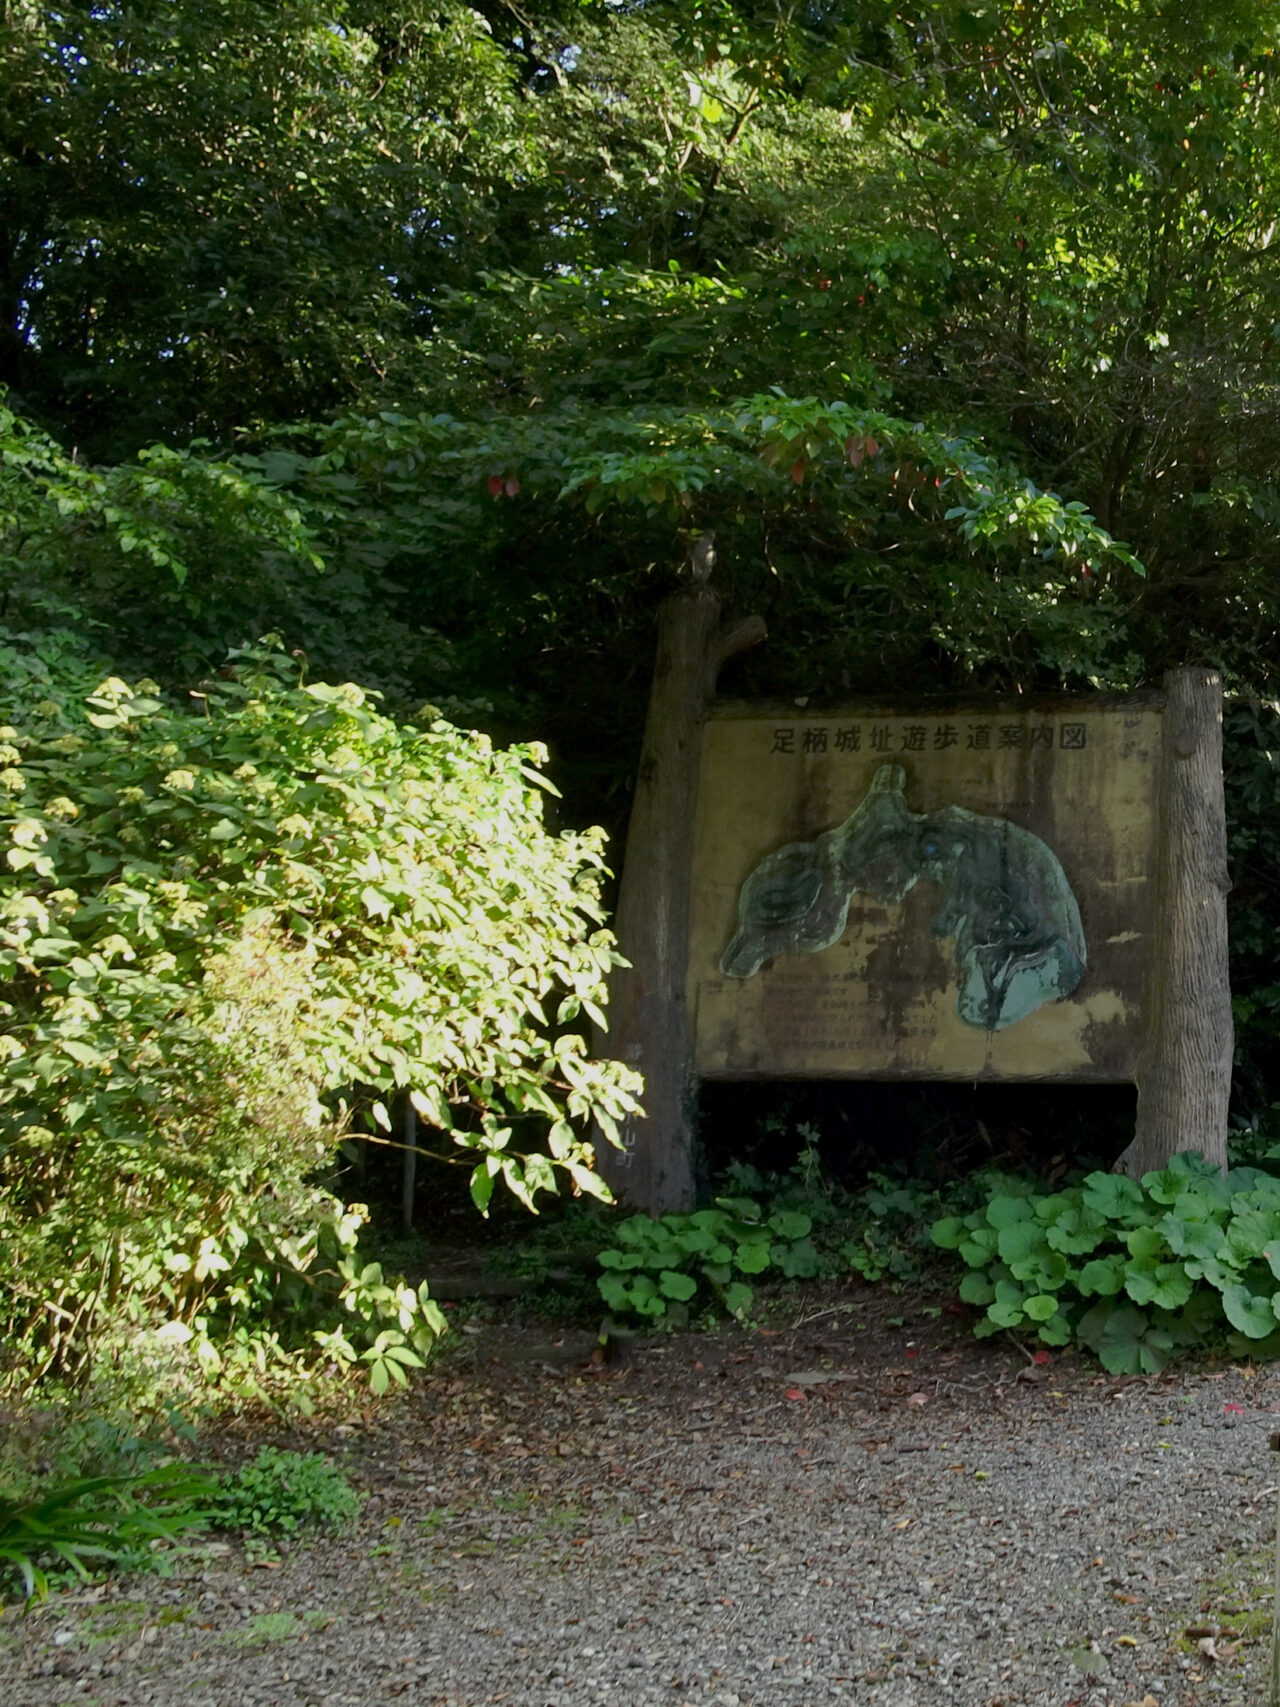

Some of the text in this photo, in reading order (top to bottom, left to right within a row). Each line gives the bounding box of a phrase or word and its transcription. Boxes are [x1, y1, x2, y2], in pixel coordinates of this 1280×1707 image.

[770, 722, 1087, 754] 足柄城址遊歩道案内図
